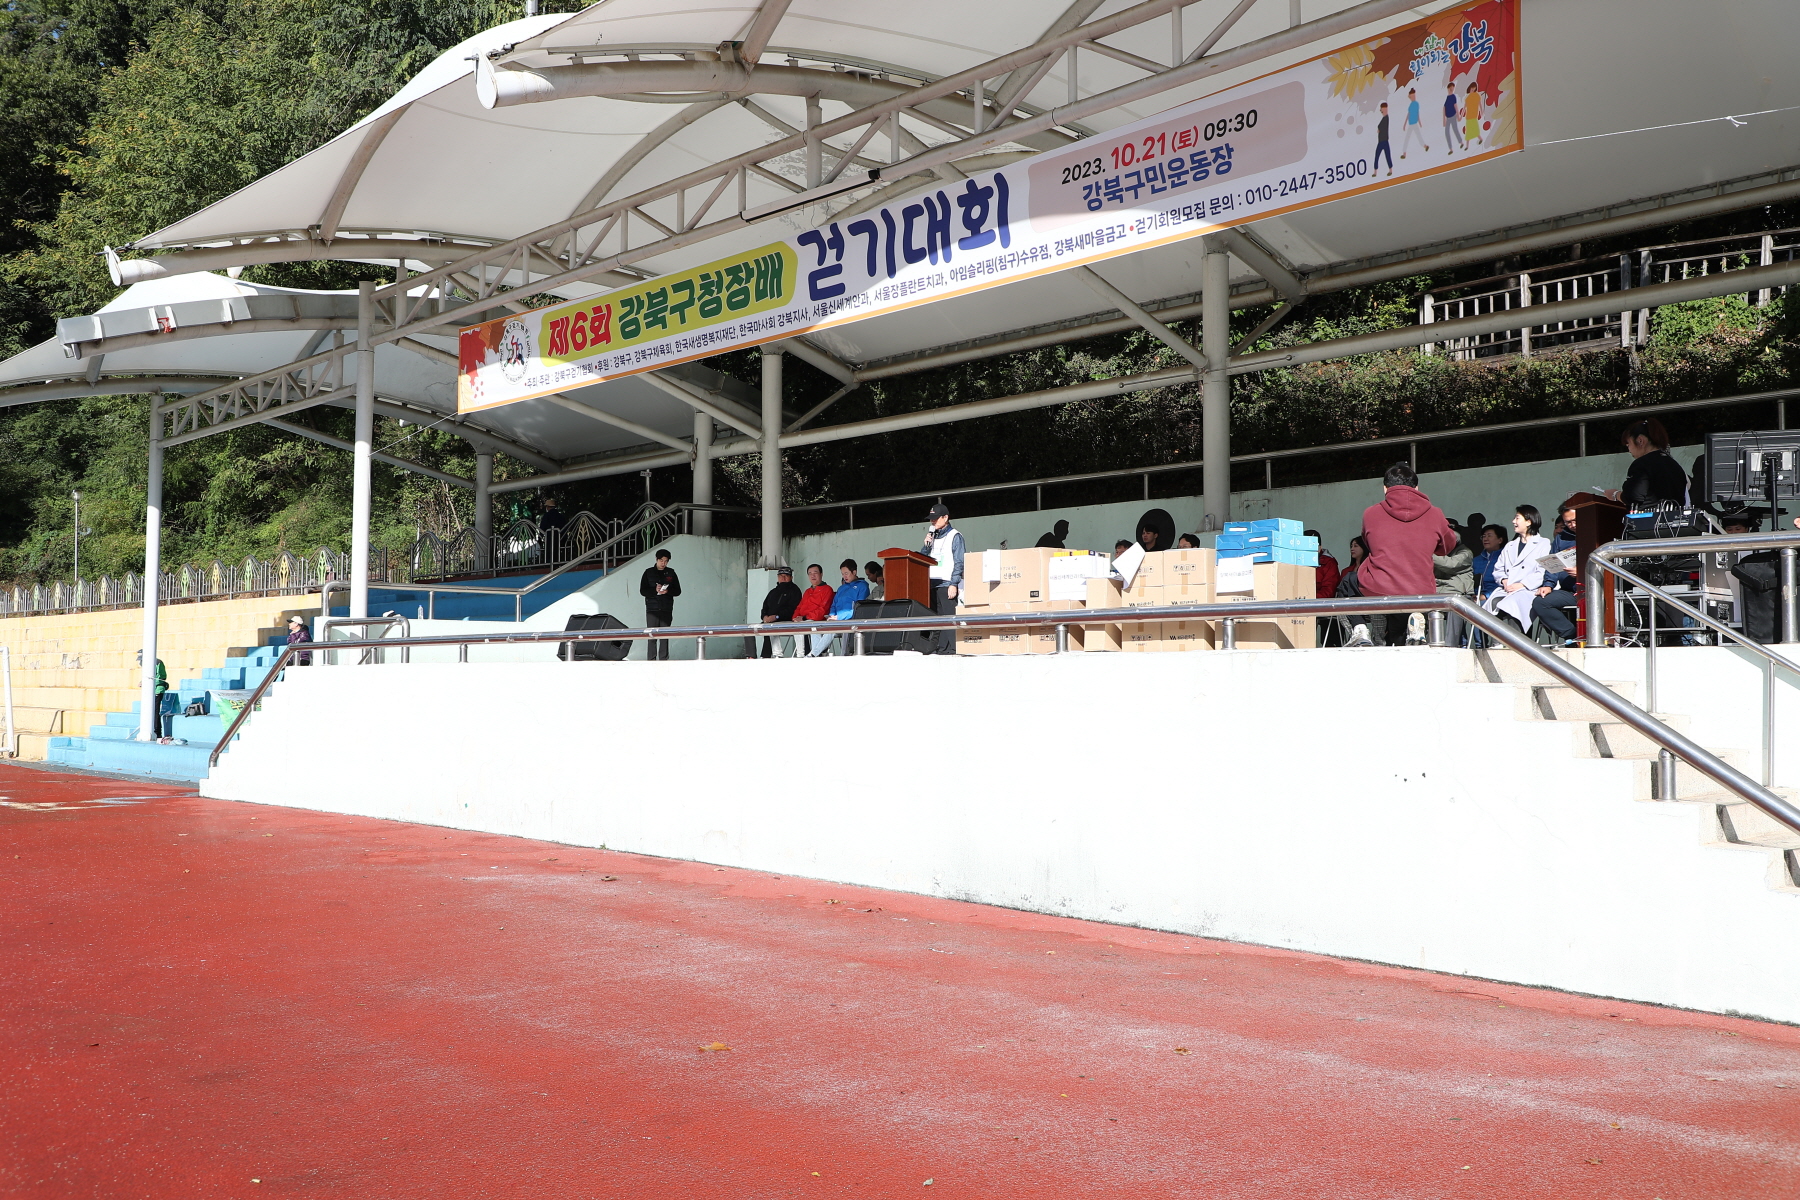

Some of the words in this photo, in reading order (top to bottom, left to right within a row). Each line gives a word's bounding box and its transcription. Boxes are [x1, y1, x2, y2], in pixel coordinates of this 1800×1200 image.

[1448, 20, 1494, 63] 강북
[1061, 158, 1106, 185] 2023.
[1111, 132, 1166, 170] 10.21
[1171, 125, 1199, 153] (토)
[1203, 109, 1258, 141] 09:30
[1082, 143, 1235, 212] 강북구민운동장
[1209, 193, 1235, 216] 문의
[1245, 158, 1368, 206] 010-2447-3500
[797, 172, 1012, 301] 걷기대회
[547, 303, 613, 357] 제6회
[618, 251, 784, 341] 강북구청장배
[739, 317, 776, 337] 한국마사회
[1054, 224, 1126, 256] 강북새마을금고
